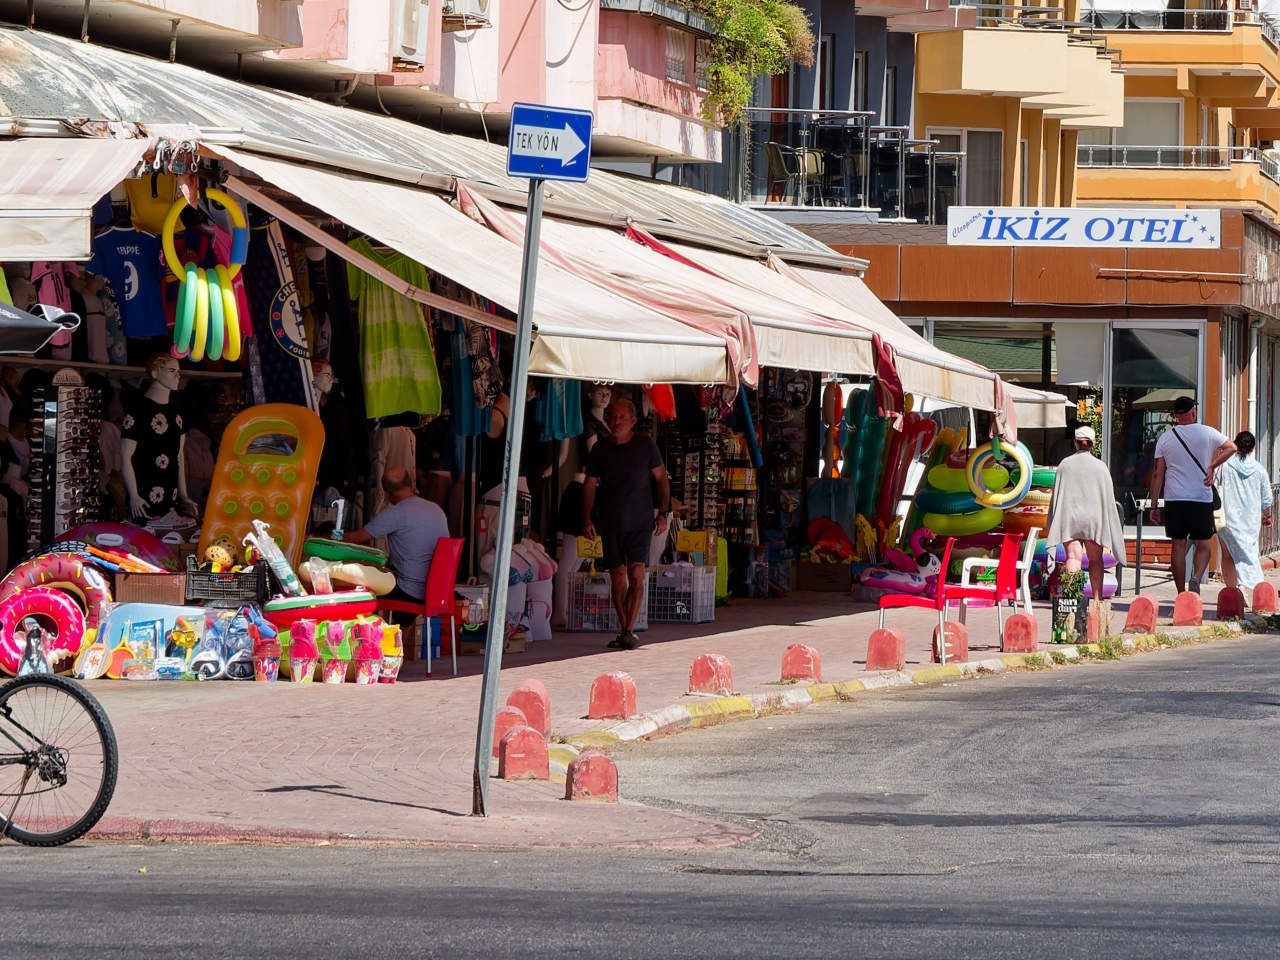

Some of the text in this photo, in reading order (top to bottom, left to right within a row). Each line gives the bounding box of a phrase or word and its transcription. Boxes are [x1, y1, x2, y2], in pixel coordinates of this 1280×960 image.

[516, 131, 559, 152] TEK YÖN
[952, 212, 982, 238] Cleopatra
[977, 209, 1194, 244] İKİZ OTEL
[278, 282, 297, 302] CHE
